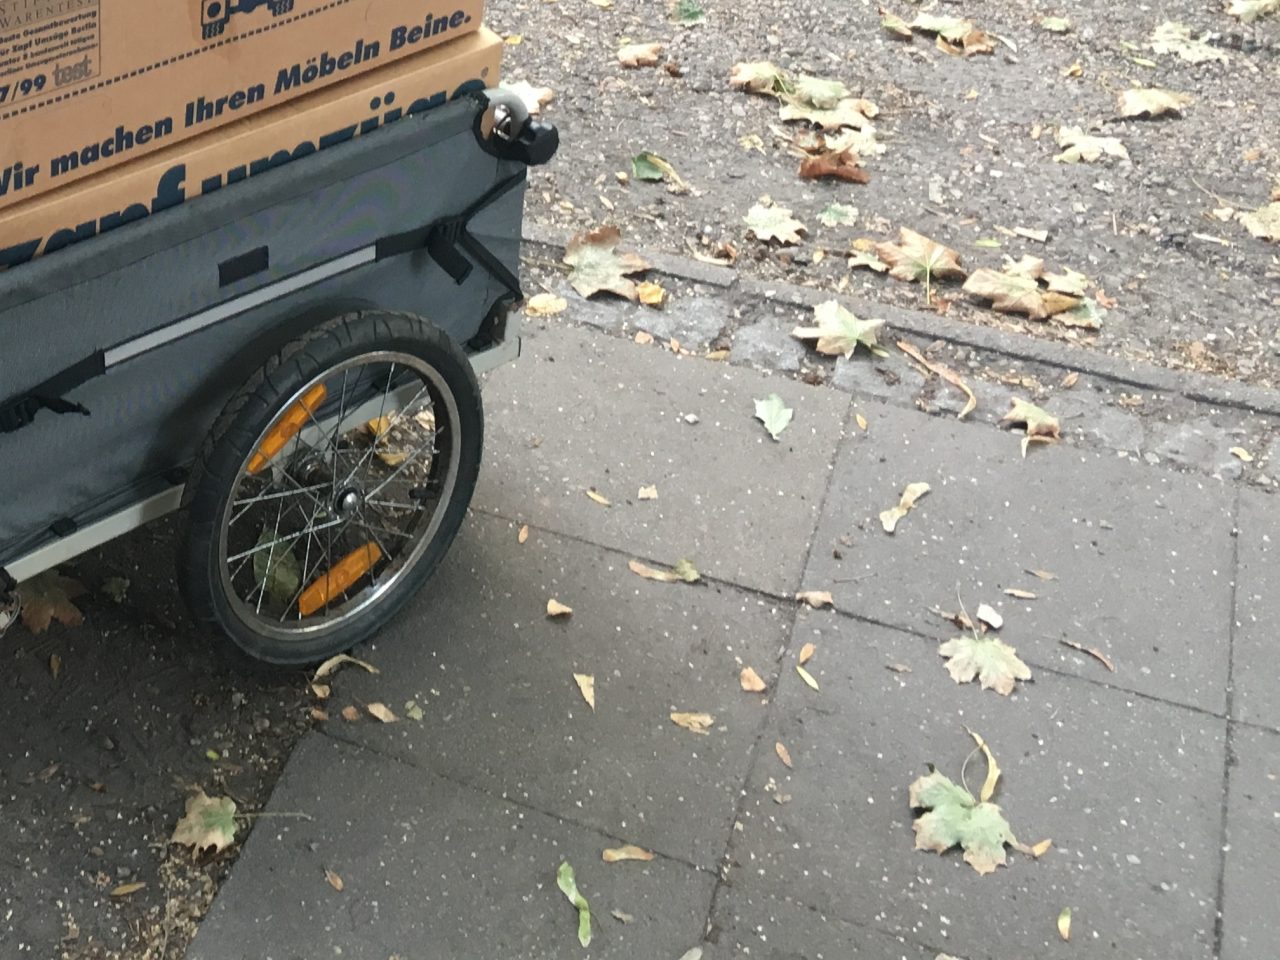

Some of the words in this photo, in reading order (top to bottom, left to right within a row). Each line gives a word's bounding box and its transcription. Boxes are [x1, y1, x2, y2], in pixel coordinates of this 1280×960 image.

[50, 116, 173, 177] machen
[184, 80, 265, 128] Ihren
[273, 55, 380, 94] Möbeln
[389, 11, 472, 50] Beine.
[52, 54, 92, 87] test
